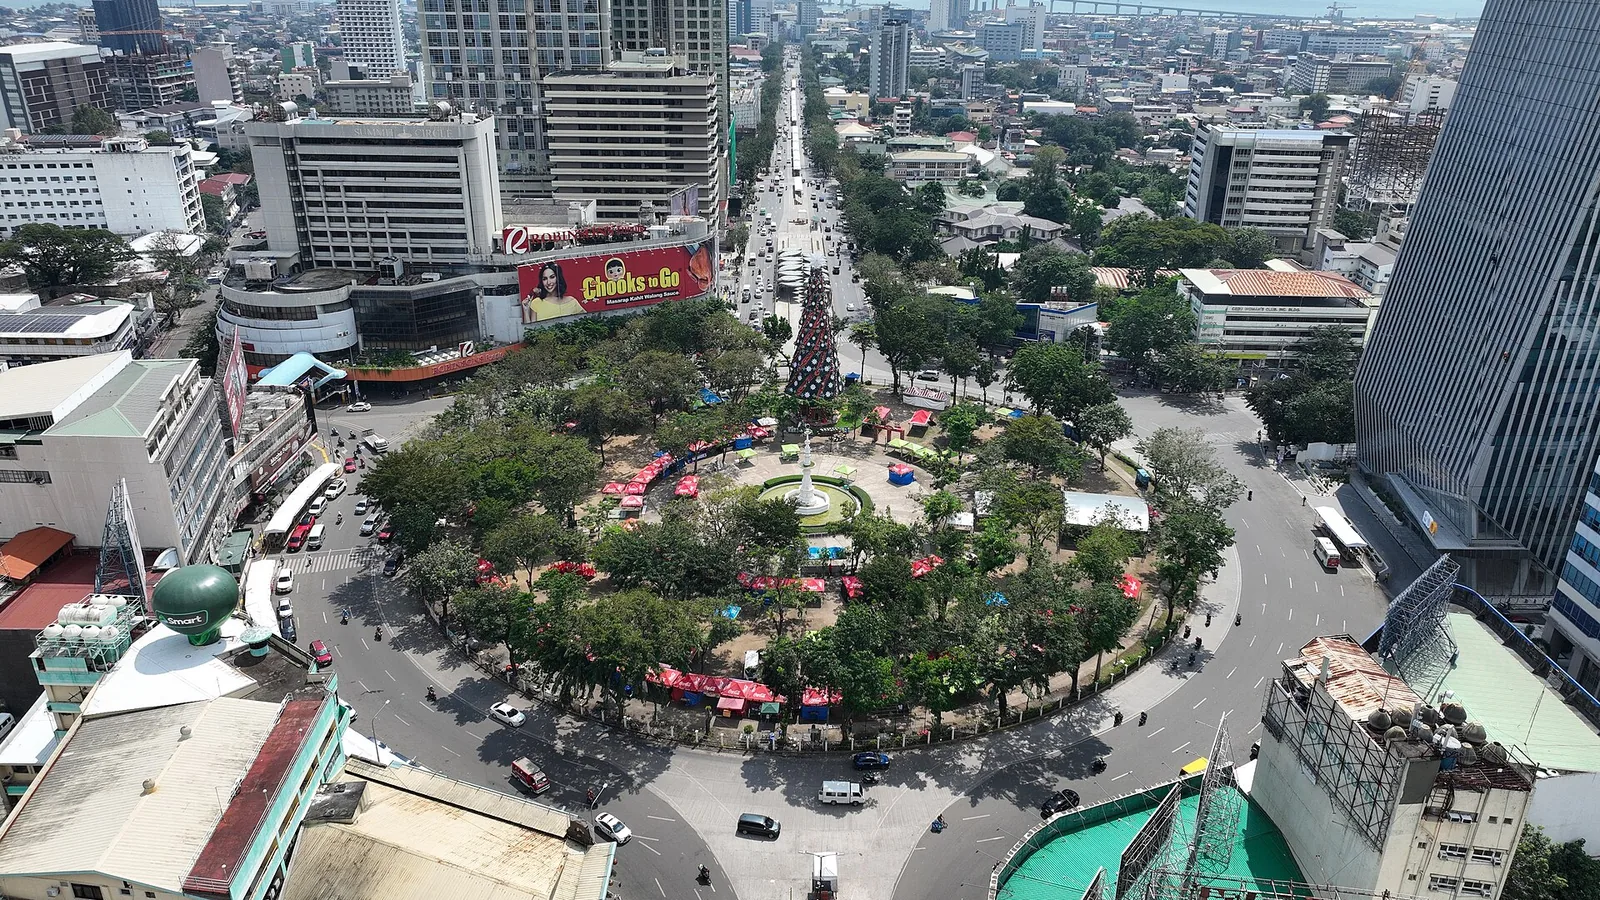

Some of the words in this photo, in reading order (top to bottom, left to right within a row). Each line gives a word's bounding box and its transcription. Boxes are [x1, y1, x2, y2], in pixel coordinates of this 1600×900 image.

[414, 129, 453, 138] CIRCLE
[582, 272, 646, 300] Chooks
[648, 276, 659, 288] to
[659, 267, 680, 289] Go
[606, 297, 630, 305] Masarap
[167, 615, 203, 625] Smart
